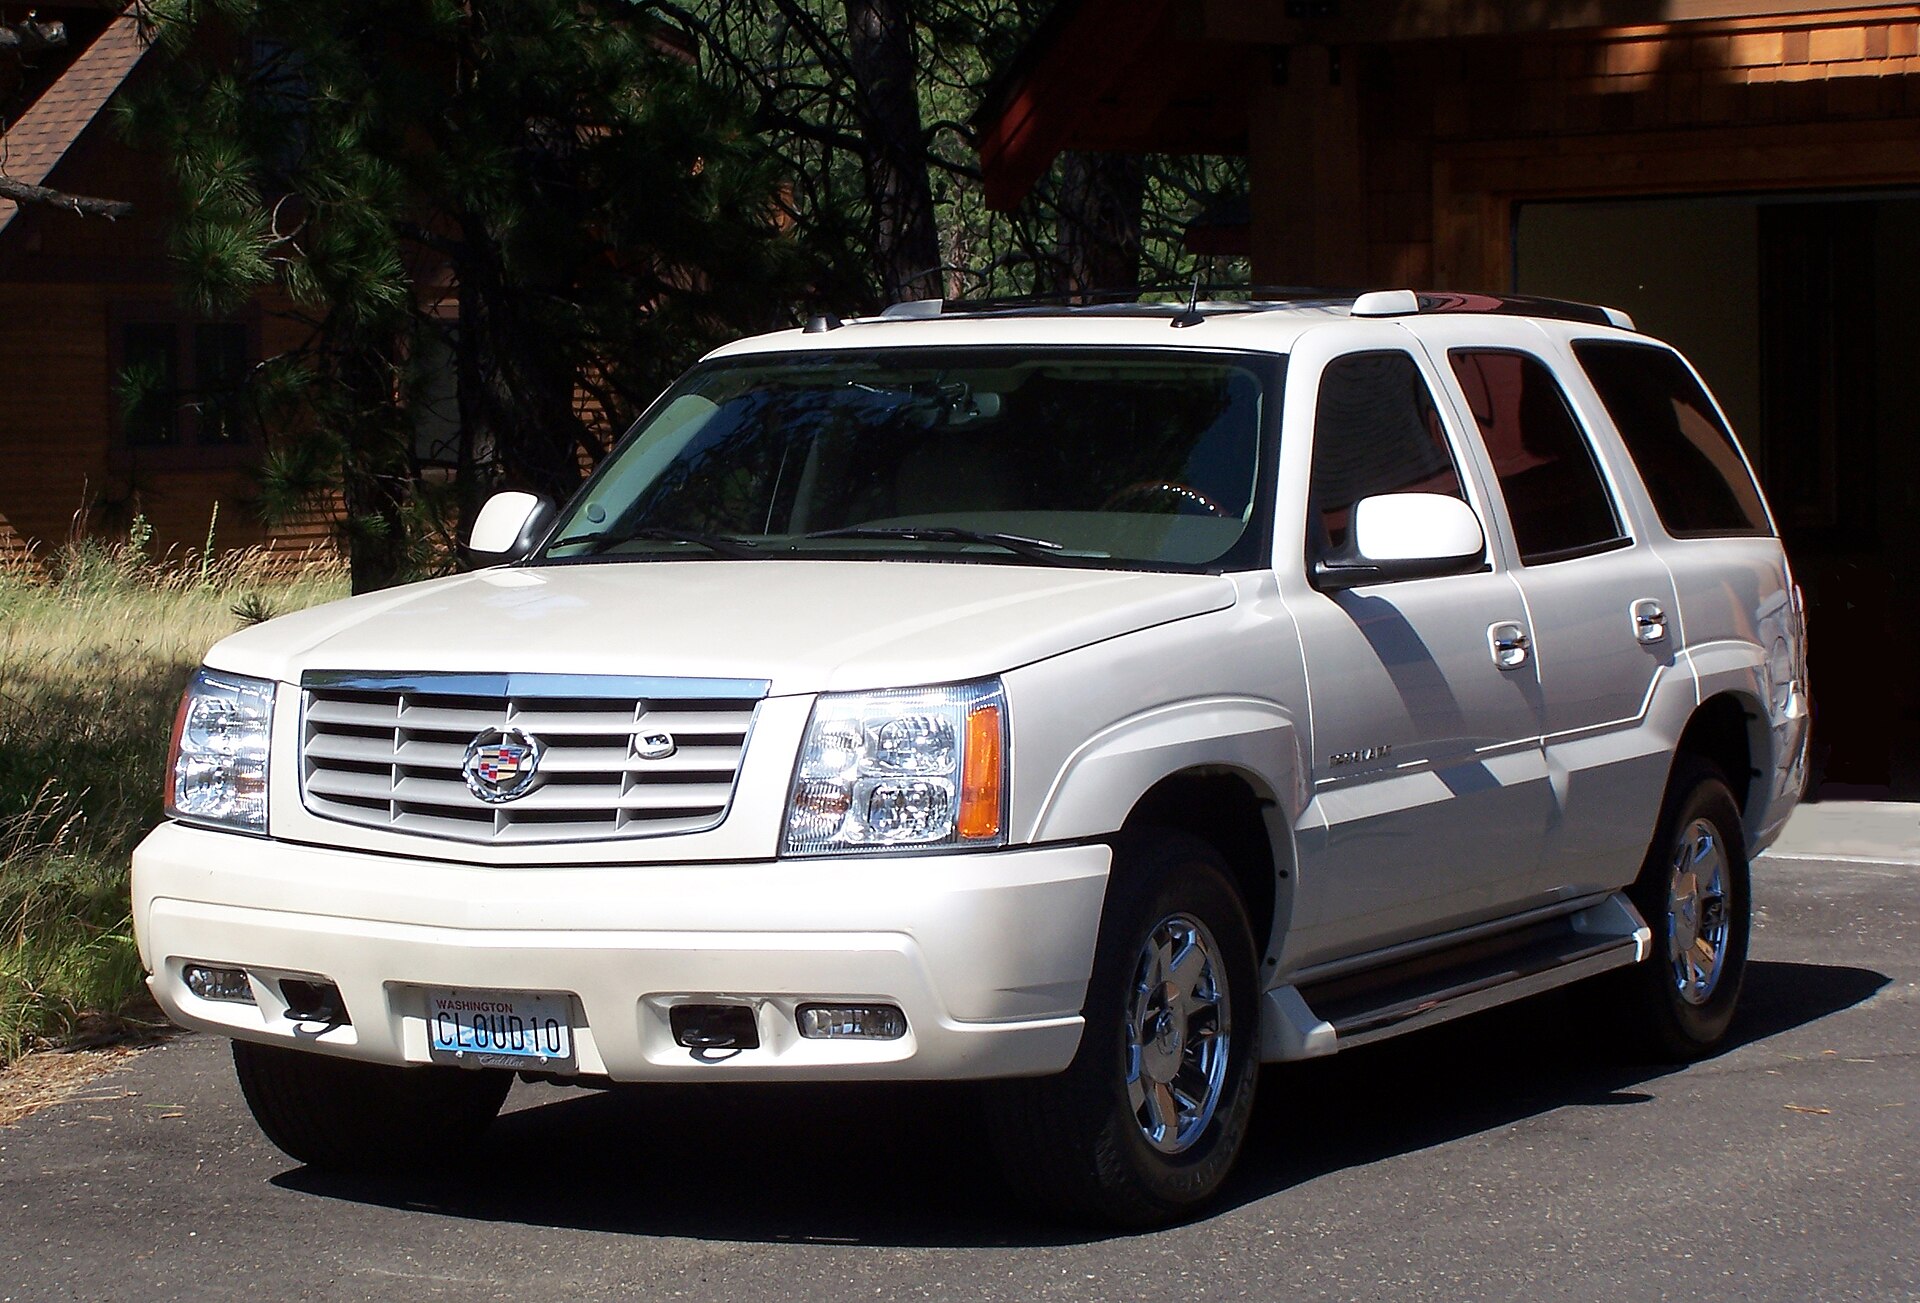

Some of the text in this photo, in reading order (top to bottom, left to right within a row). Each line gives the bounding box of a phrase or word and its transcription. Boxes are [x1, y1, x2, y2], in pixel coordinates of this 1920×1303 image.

[436, 1000, 513, 1013] WASHINGTON
[437, 1012, 561, 1053] CLOUD10
[478, 1054, 525, 1067] Cadillac
